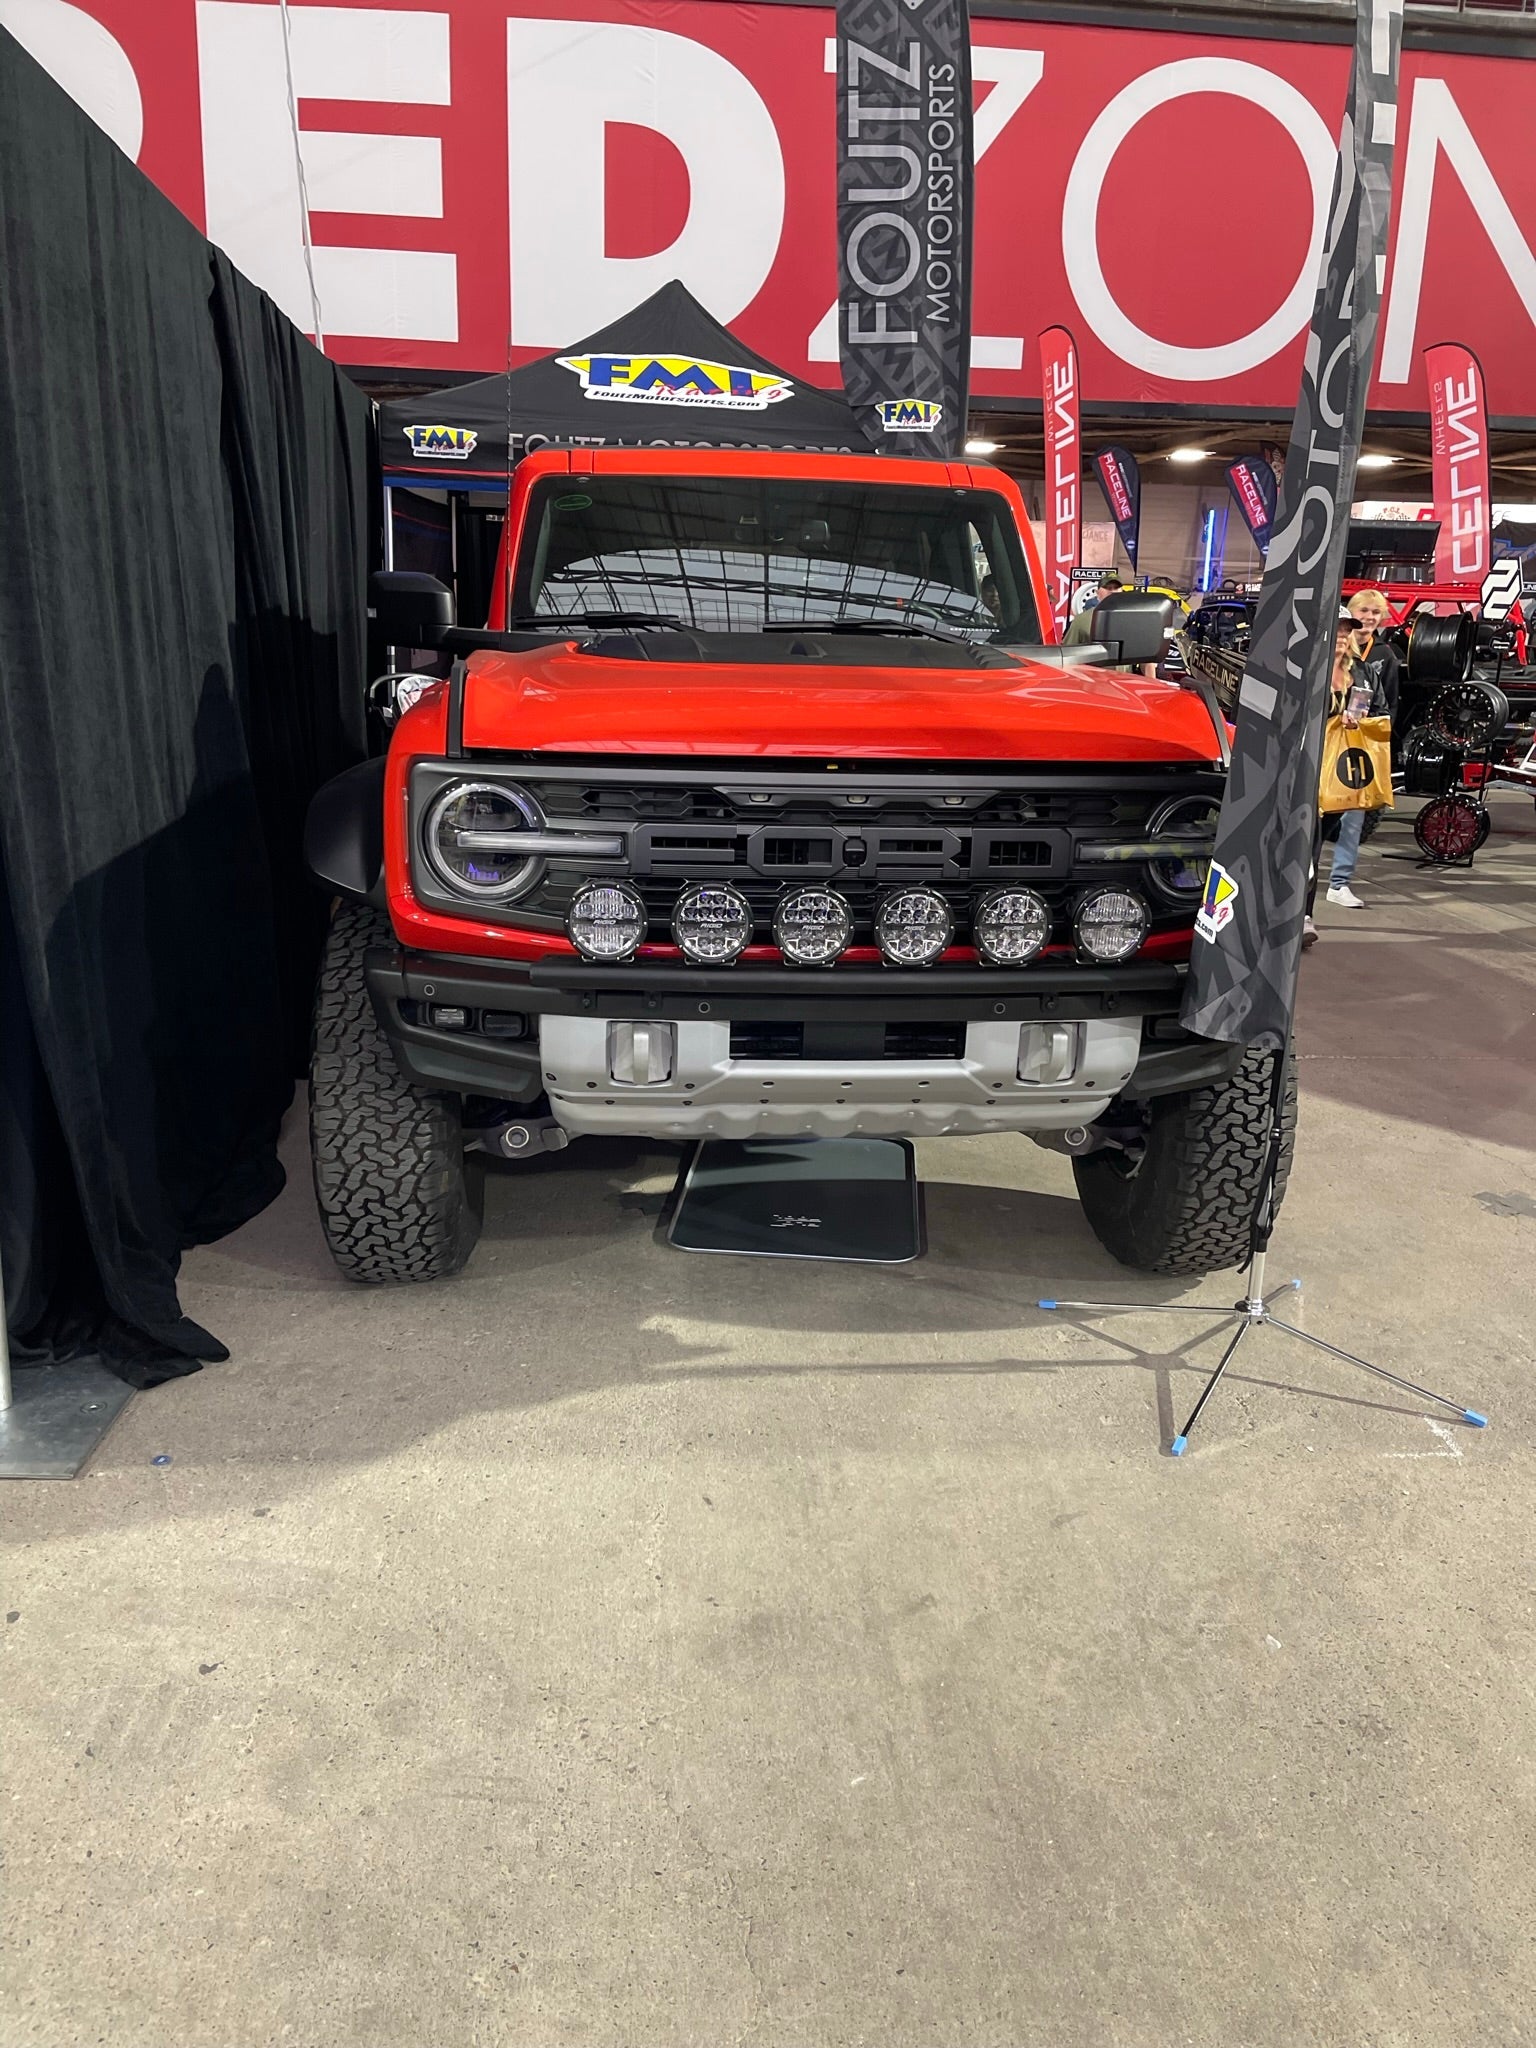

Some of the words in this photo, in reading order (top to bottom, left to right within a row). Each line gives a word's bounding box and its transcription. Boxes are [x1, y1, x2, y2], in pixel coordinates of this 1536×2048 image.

[847, 39, 922, 344] FOUTZ
[926, 62, 955, 323] MOTORSPORTS
[588, 357, 755, 398] FMI
[593, 389, 761, 408] FoutzMotorsports.com
[884, 403, 931, 422] FMI
[413, 427, 466, 450] FMI
[1103, 452, 1133, 519] RACELINE
[1235, 463, 1268, 526] RACELINE
[1192, 648, 1239, 692] RACELINE
[1346, 755, 1367, 781] H
[630, 824, 1071, 877] FORD
